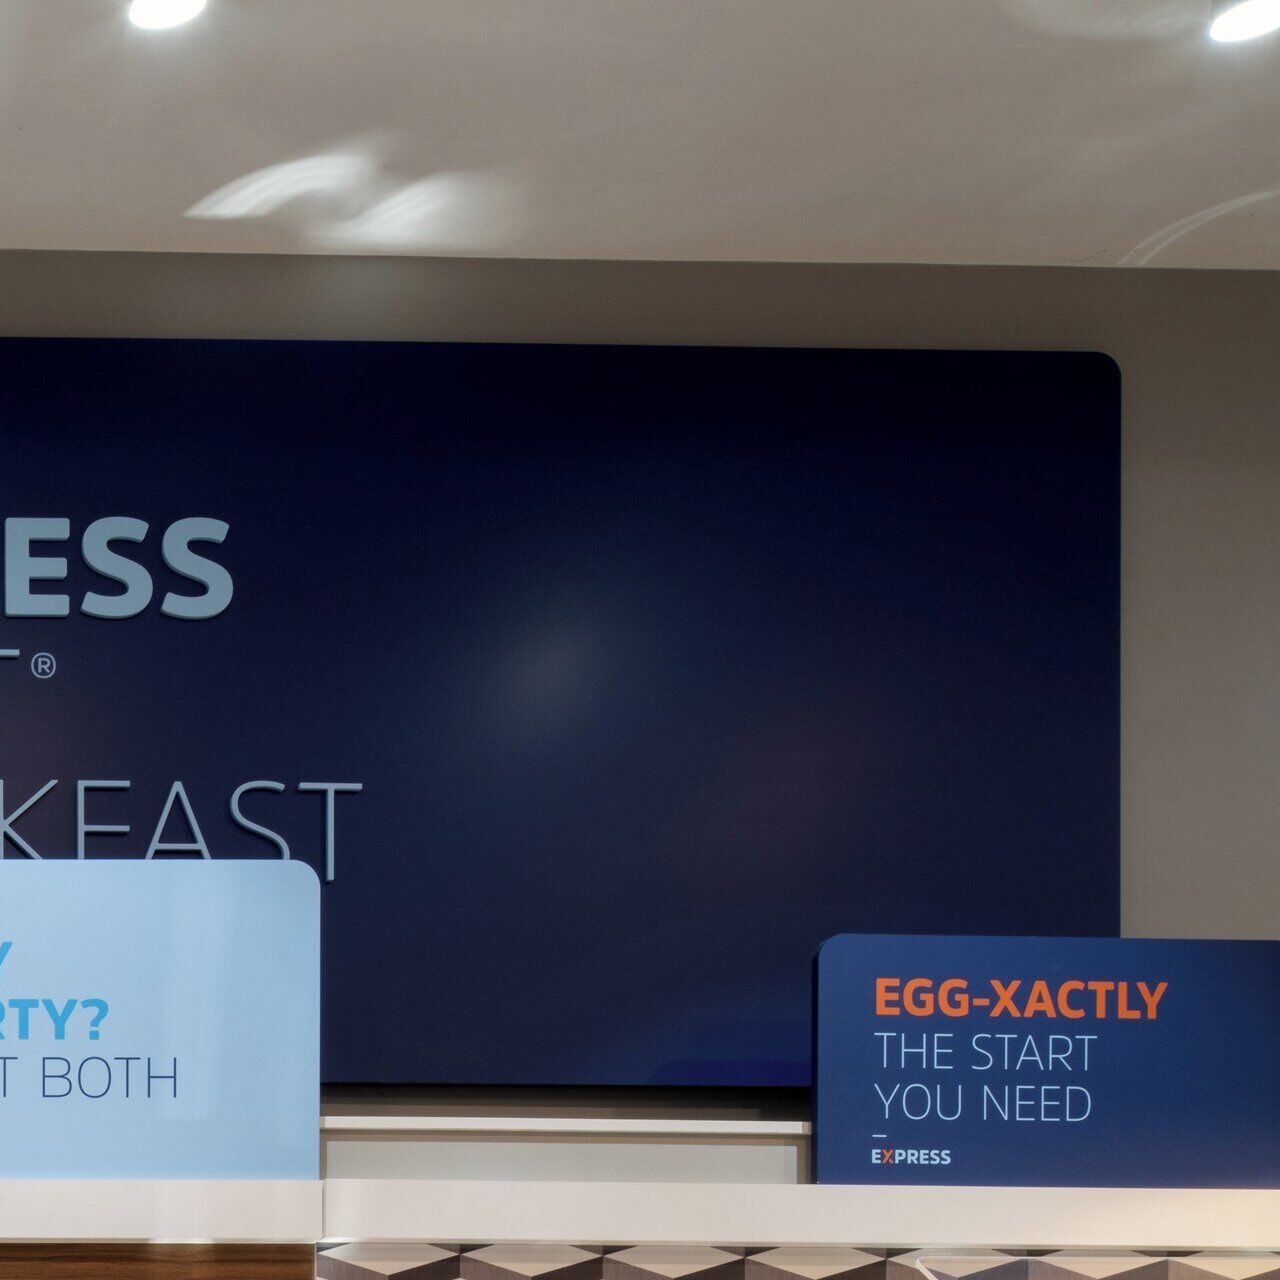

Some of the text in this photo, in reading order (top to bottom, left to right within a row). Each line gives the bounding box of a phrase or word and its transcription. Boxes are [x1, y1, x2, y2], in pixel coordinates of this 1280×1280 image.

[875, 977, 1169, 1020] EGG-XACTLY
[874, 1032, 1098, 1072] THE START
[41, 1056, 179, 1100] BOTH
[874, 1083, 1092, 1123] YOU NEED
[871, 1148, 952, 1165] EXPRESS
